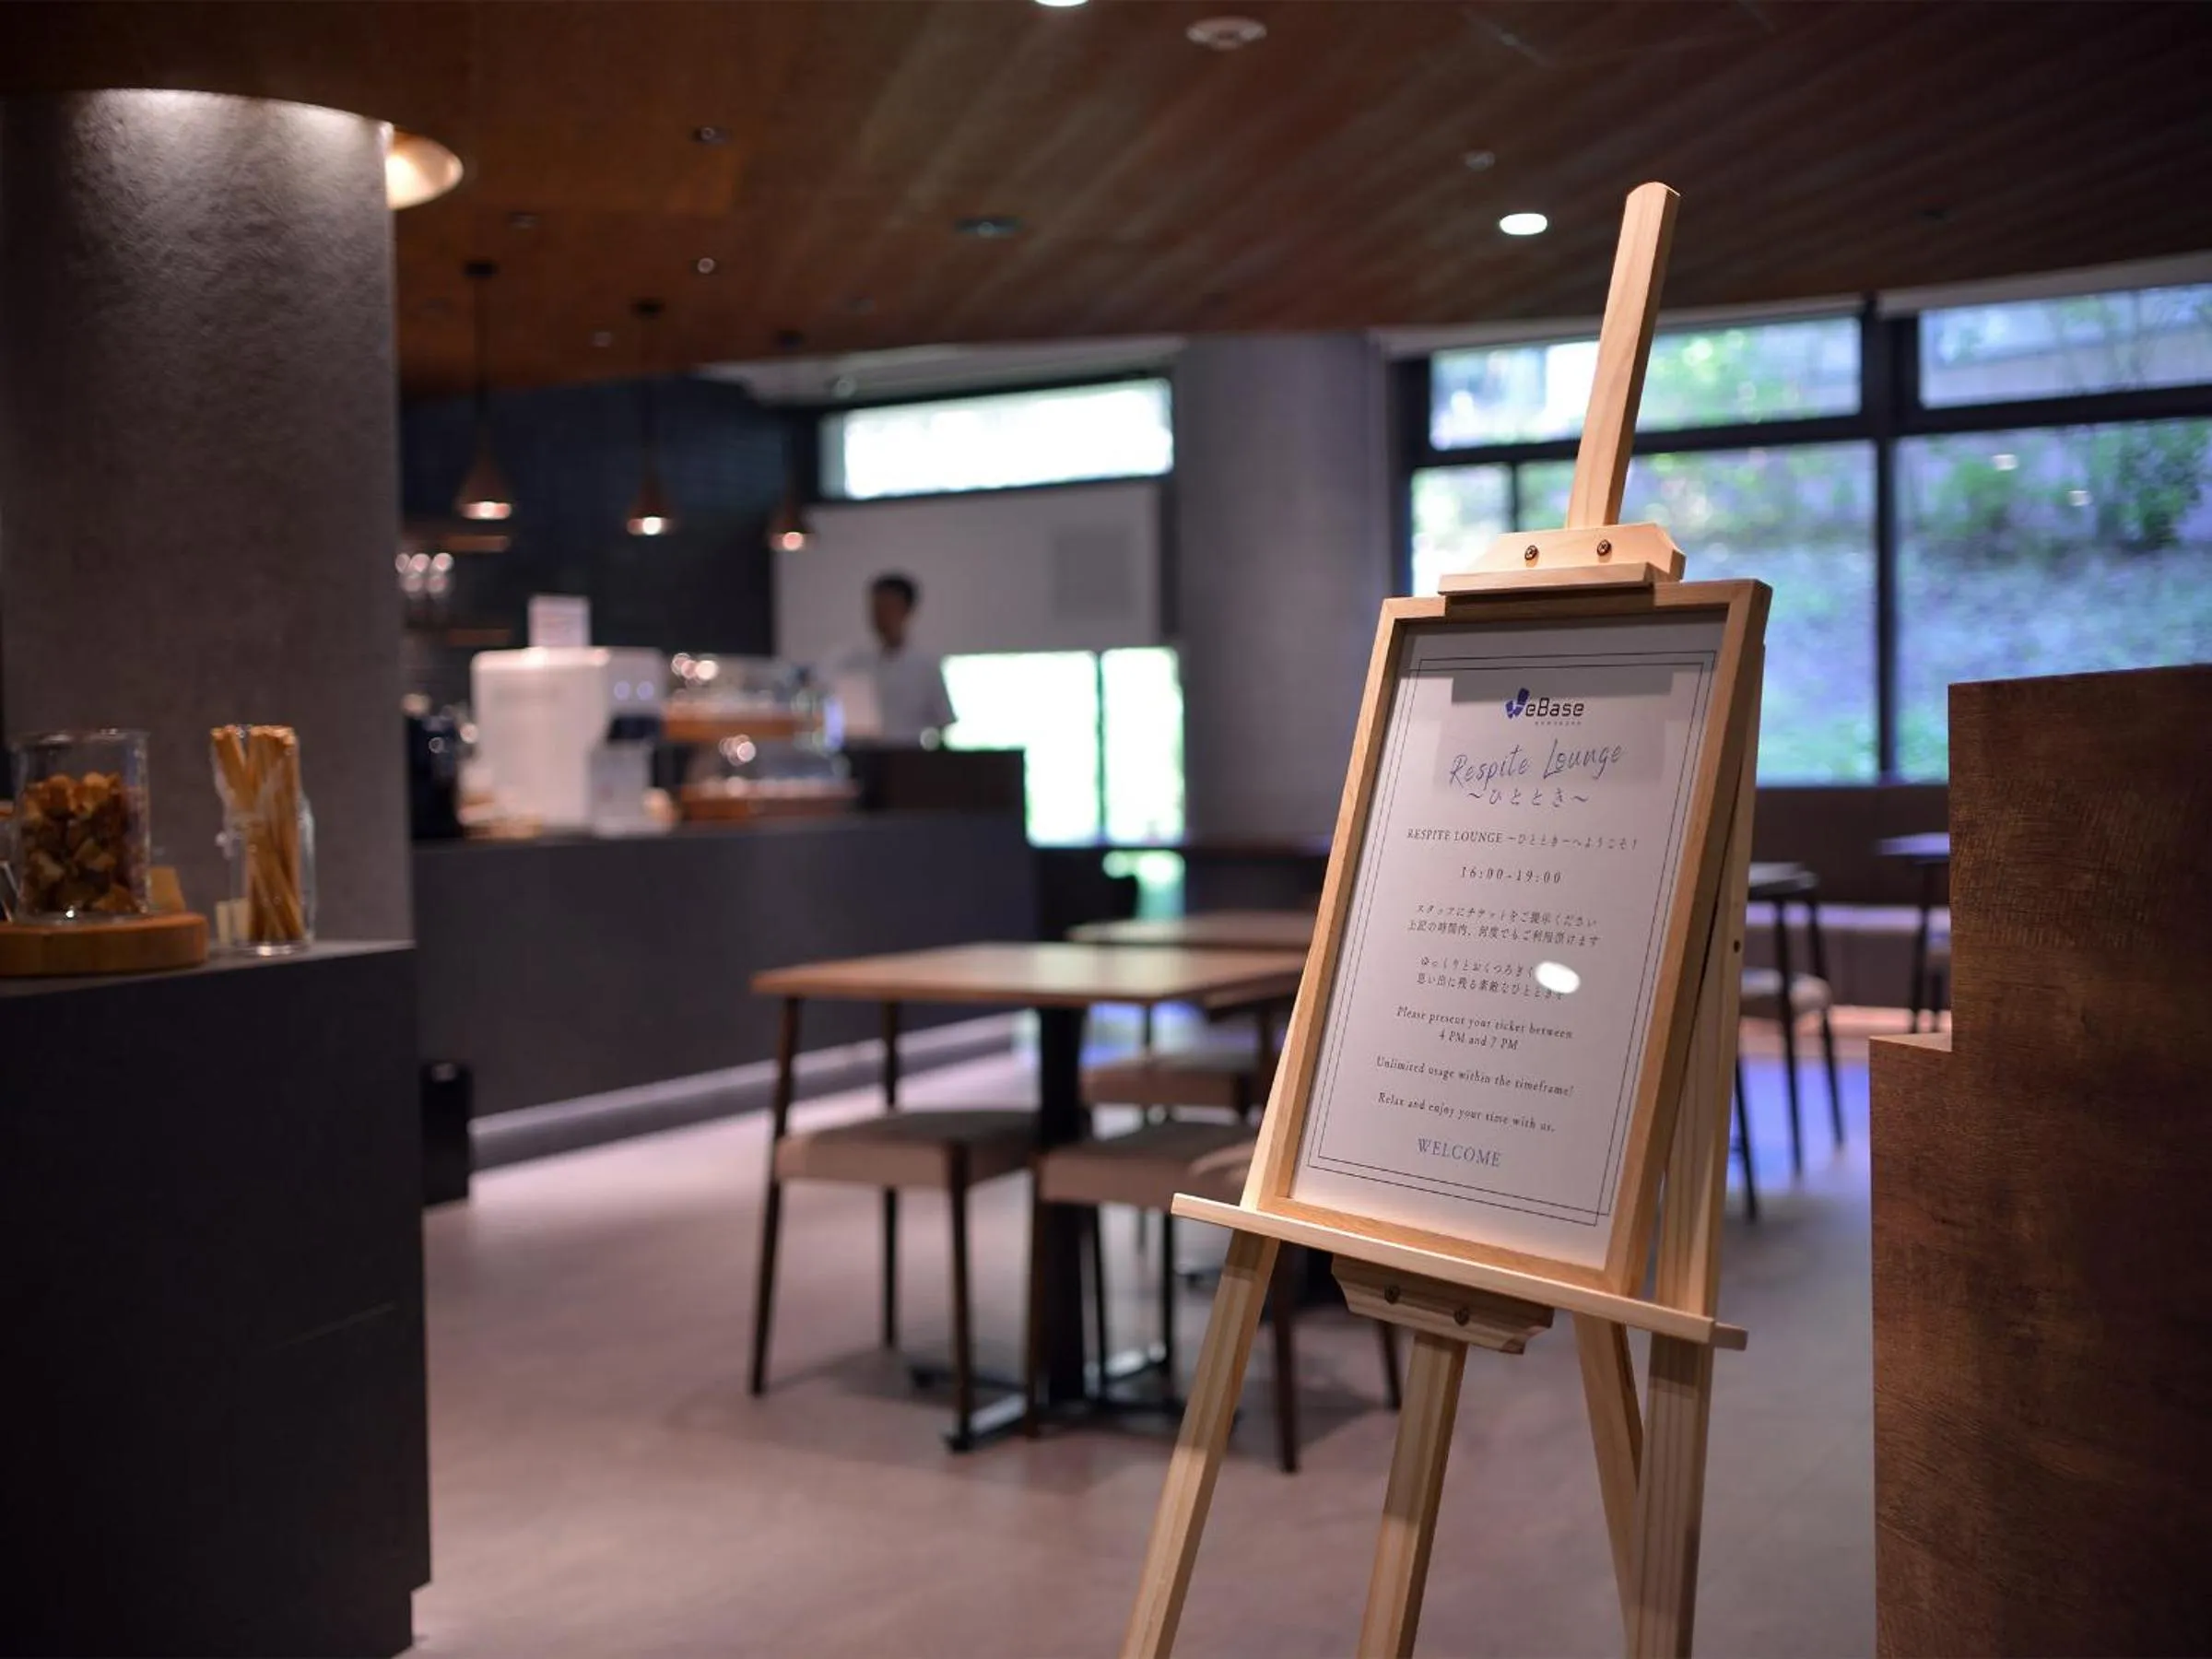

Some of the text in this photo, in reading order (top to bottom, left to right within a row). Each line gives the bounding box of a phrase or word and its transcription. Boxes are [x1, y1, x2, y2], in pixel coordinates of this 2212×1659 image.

[1449, 737, 1626, 790] Respite Lounge
[1406, 829, 1451, 841] RESPITE
[1454, 830, 1503, 843] LOUNGE
[1397, 1006, 1572, 1040] Please present your ticket between
[1439, 1030, 1519, 1051] 4 PM and 7 PM
[1377, 1056, 1574, 1098] Unlimited usage within the timeframe!
[1378, 1092, 1405, 1107] Relax
[1407, 1098, 1425, 1111] and
[1429, 1102, 1454, 1117] enjoy
[1459, 1109, 1482, 1122] your
[1486, 1112, 1509, 1125] time
[1512, 1117, 1536, 1131] with
[1418, 1137, 1501, 1168] WELCOME
